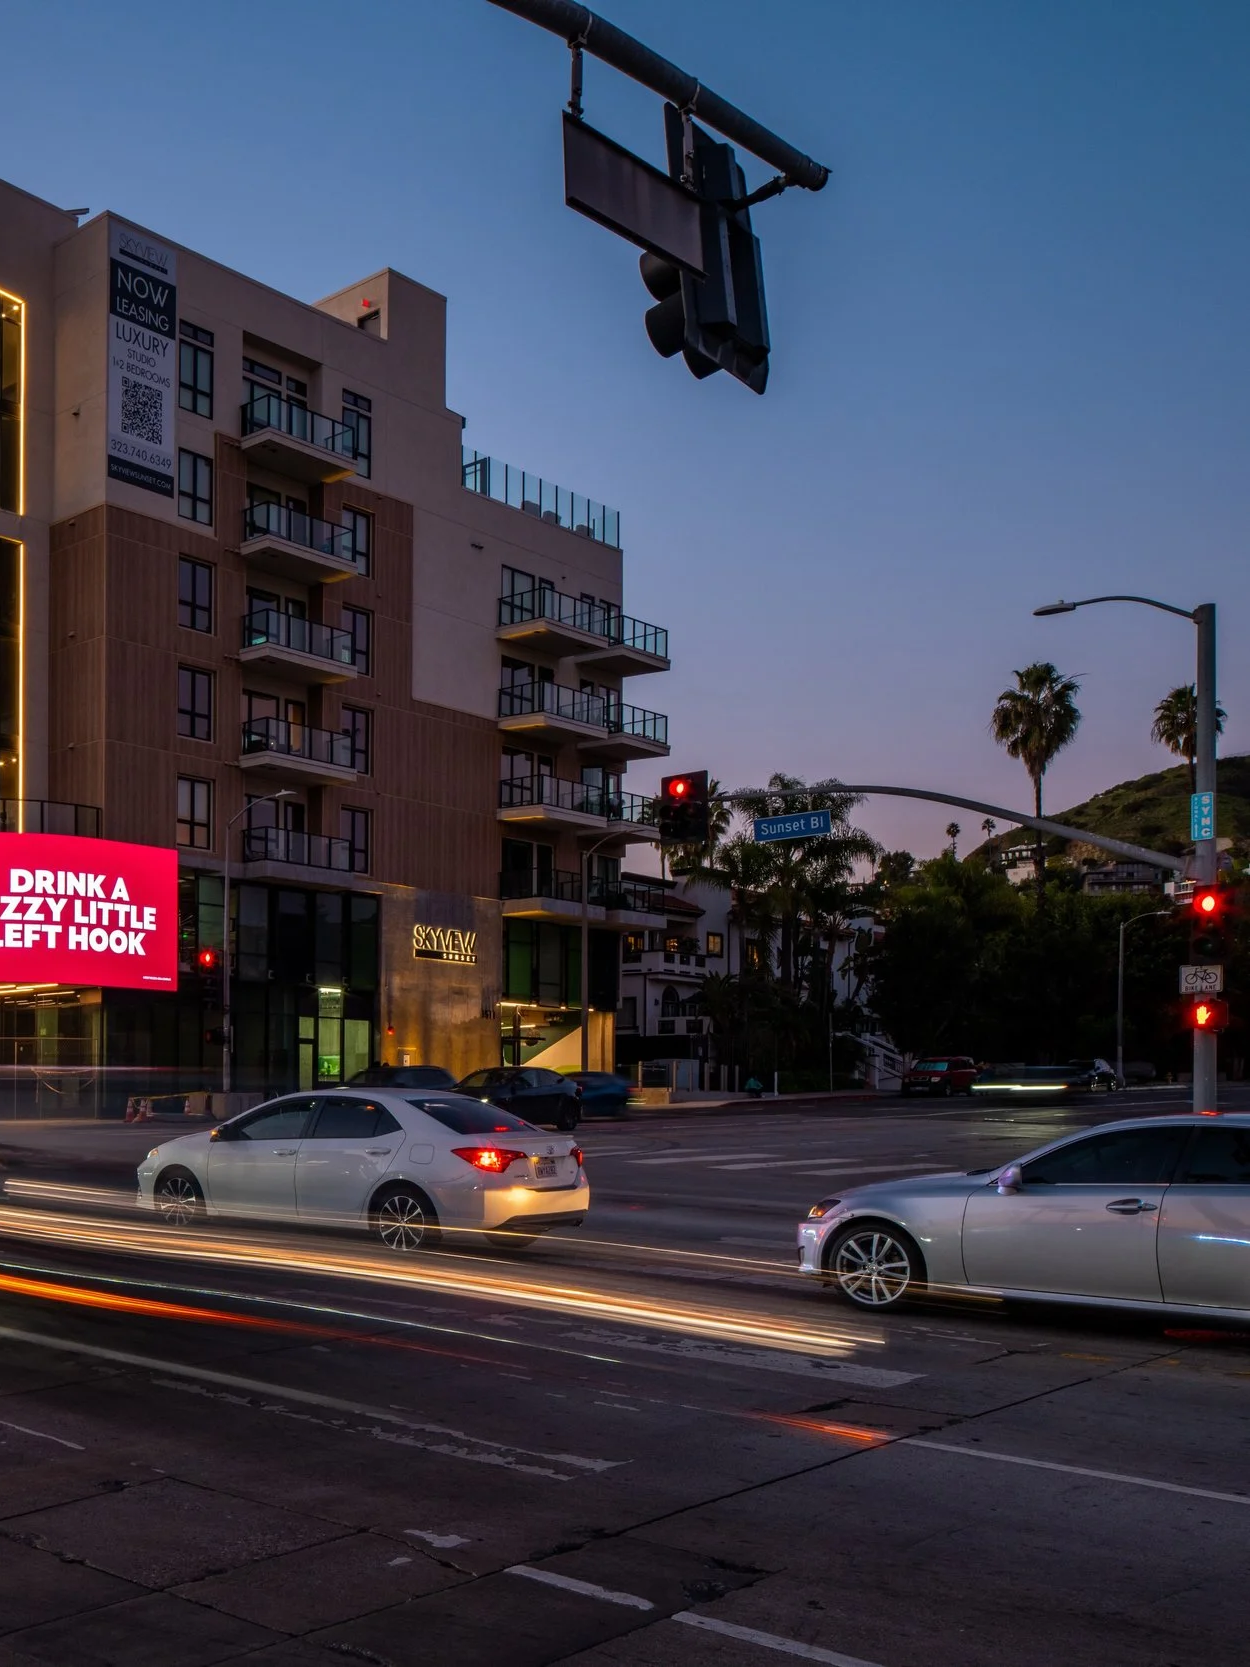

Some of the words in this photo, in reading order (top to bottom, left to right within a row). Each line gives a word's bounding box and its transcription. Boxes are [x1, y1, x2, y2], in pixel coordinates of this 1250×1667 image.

[117, 267, 169, 308] NOW
[116, 295, 169, 331] LEASING
[116, 321, 169, 357] LUXURY
[127, 348, 156, 367] STUDIO
[127, 362, 170, 388] BEDROOMS
[111, 439, 172, 469] 323.740.6349
[760, 819, 806, 835] Sunset
[810, 816, 824, 829] Bl
[1201, 795, 1211, 837] SYNC
[9, 868, 106, 898] DRINK
[110, 877, 130, 901] A
[74, 899, 157, 931] LITTLE
[68, 926, 146, 956] HOOK
[413, 925, 478, 955] SKYVIEW
[443, 953, 476, 962] SUNSET
